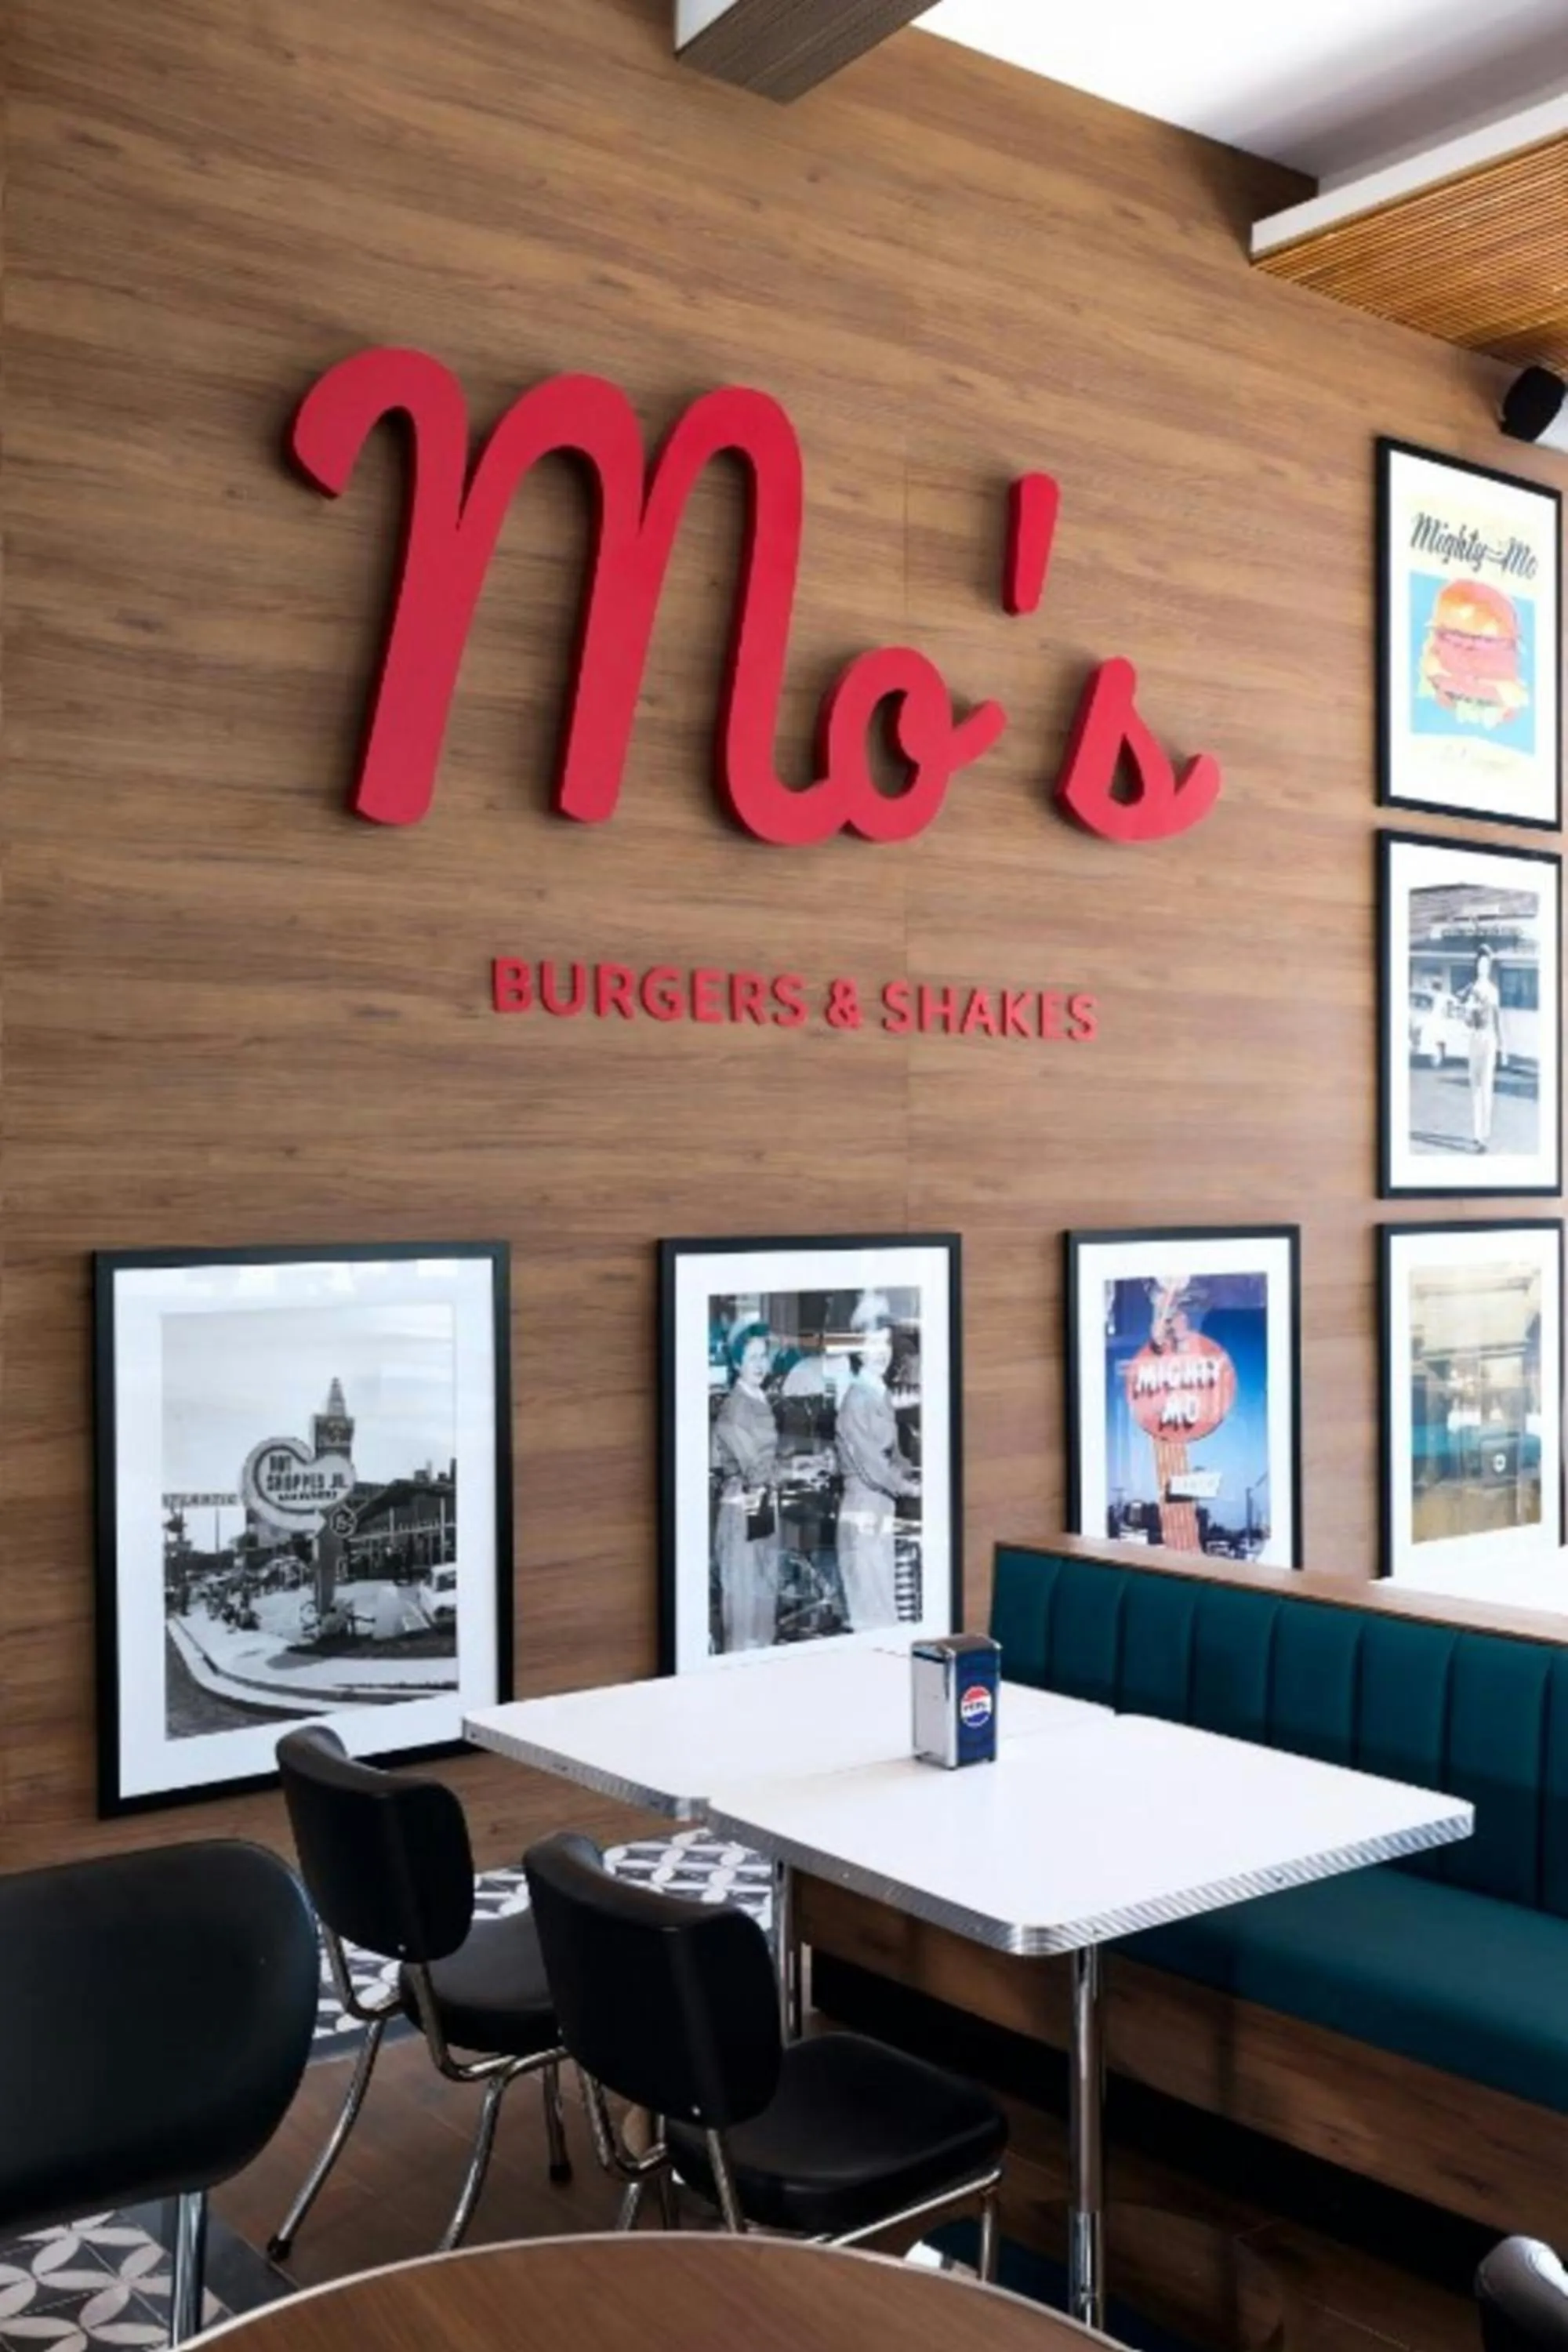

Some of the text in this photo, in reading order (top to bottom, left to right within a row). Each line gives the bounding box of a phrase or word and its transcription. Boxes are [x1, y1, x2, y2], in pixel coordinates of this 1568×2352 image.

[288, 347, 1221, 846] Mo's
[491, 956, 1098, 1043] BURGERS & SHAKES
[1161, 1392, 1200, 1425] MO
